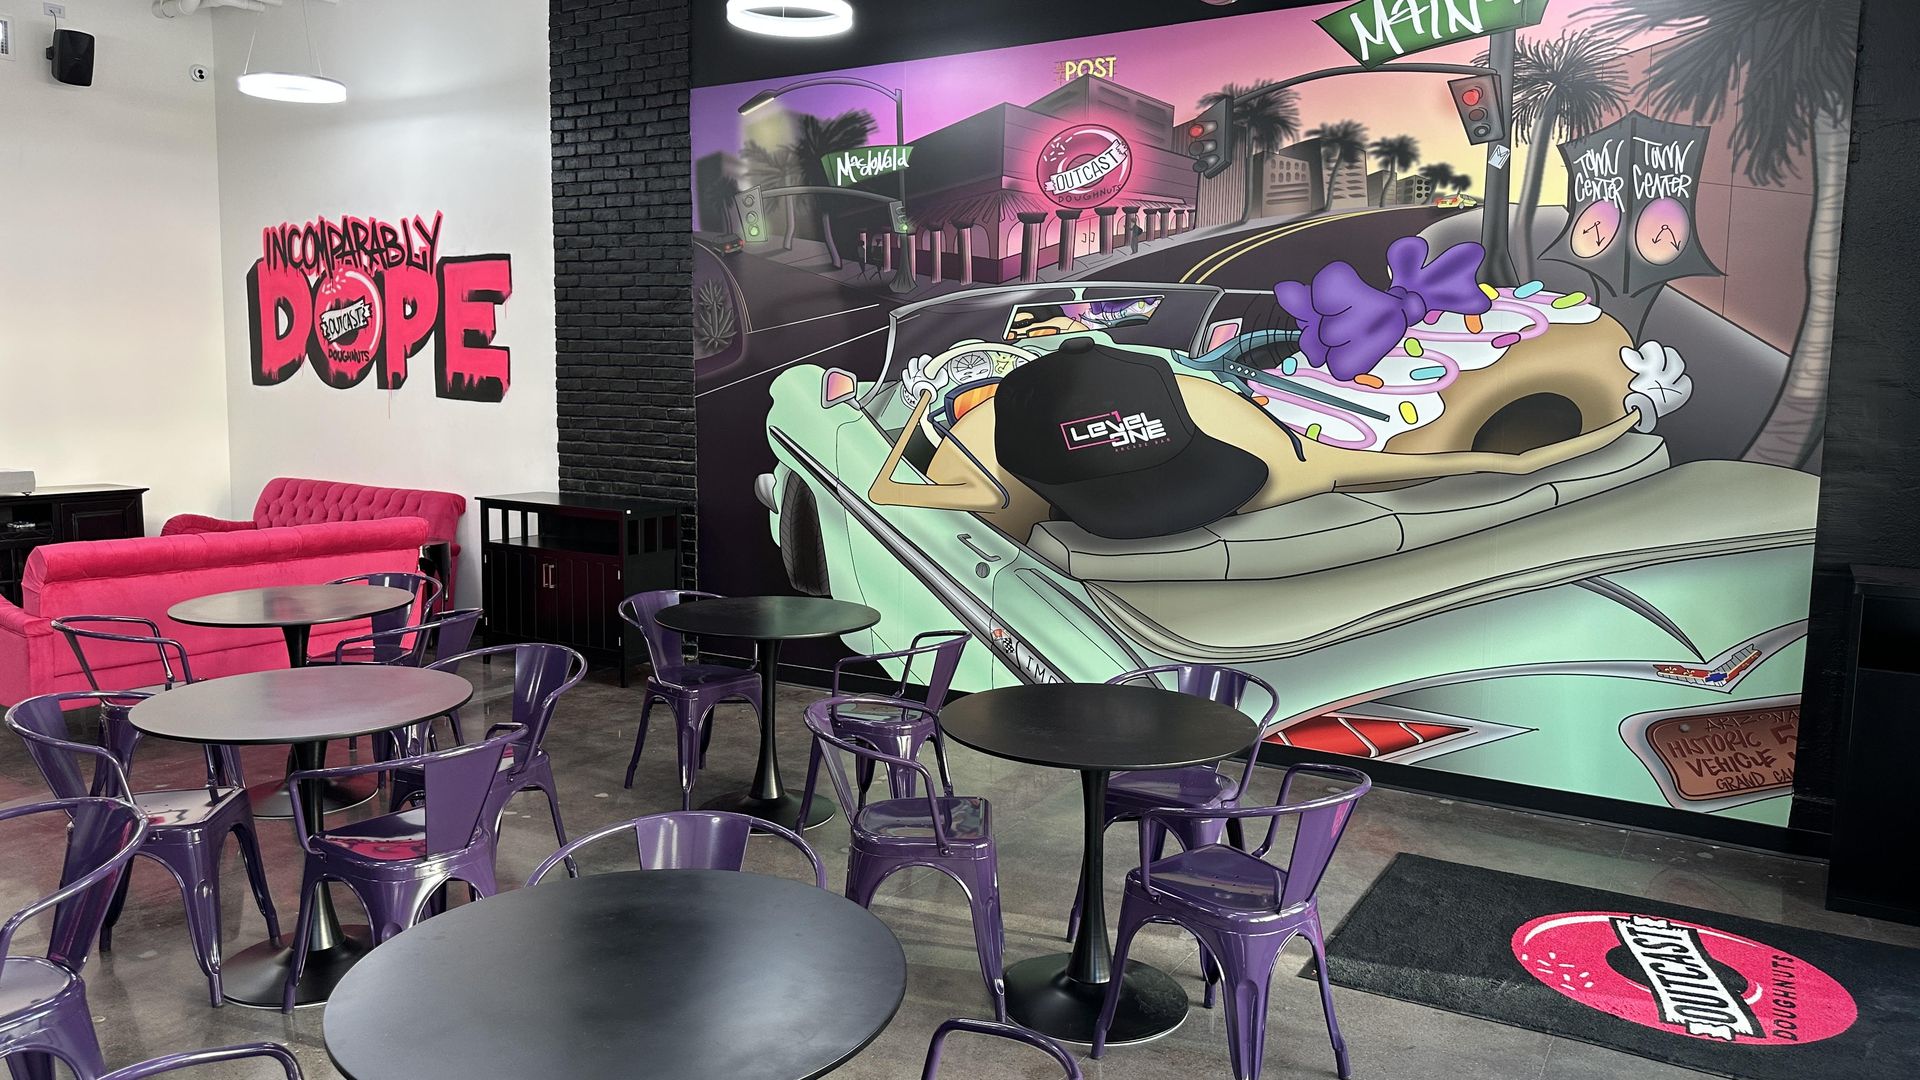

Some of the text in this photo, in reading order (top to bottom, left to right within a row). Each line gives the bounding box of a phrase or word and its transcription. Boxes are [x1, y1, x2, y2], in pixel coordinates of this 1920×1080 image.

[1350, 0, 1484, 61] MAIN
[1065, 56, 1117, 81] POST
[1055, 149, 1119, 192] OUTCAST
[1574, 139, 1624, 178] TOWN
[1633, 136, 1694, 174] TOWN
[264, 213, 442, 279] INCOMPARABLY
[246, 253, 513, 403] DOPE
[328, 306, 364, 335] OUTCAST
[328, 349, 370, 363] DOUGHNUTS
[1109, 423, 1167, 447] ONE
[1666, 729, 1762, 759] HISTORIC
[1685, 749, 1777, 778] VEHICLE
[1716, 772, 1766, 791] GRAND
[1626, 926, 1739, 1024] OUTCAST
[1771, 954, 1798, 1041] DOUGHNUTS
